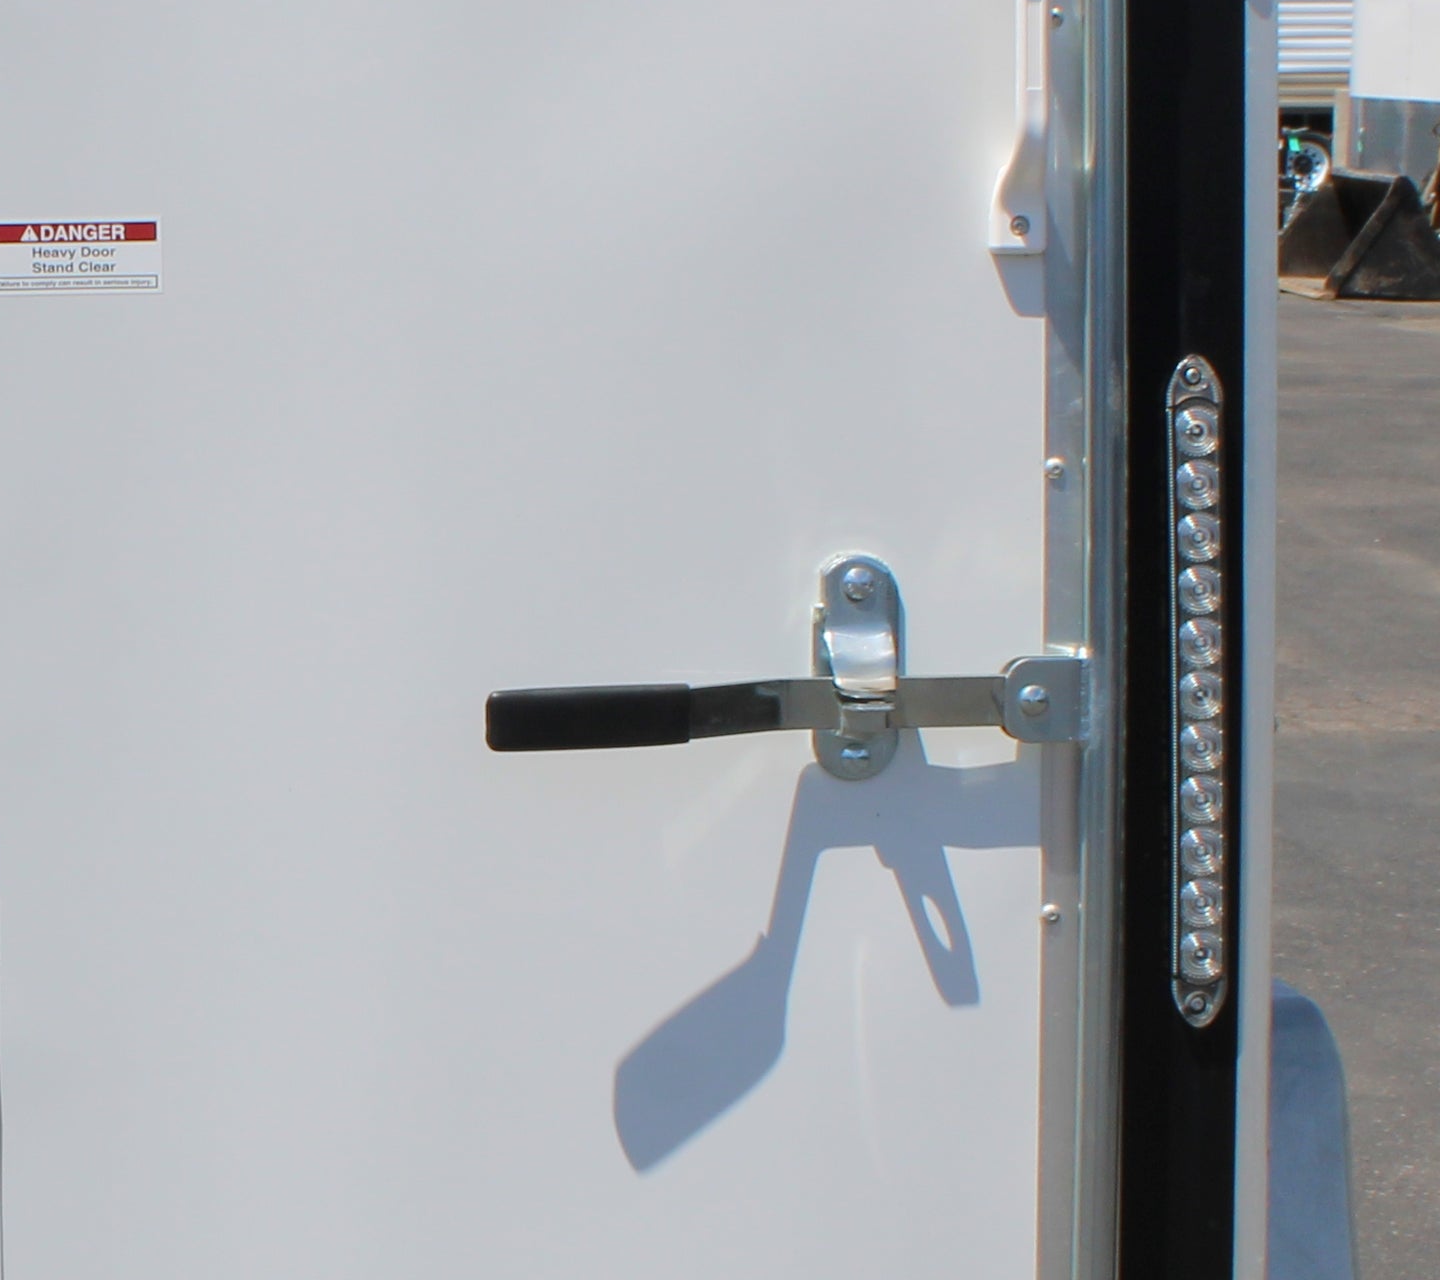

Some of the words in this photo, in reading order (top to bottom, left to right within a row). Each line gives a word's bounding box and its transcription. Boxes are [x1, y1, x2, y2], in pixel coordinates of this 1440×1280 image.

[39, 223, 126, 242] DANGER
[31, 247, 77, 260] Heavy
[80, 245, 117, 258] Door
[31, 261, 74, 274] Stand
[78, 260, 117, 273] Clear
